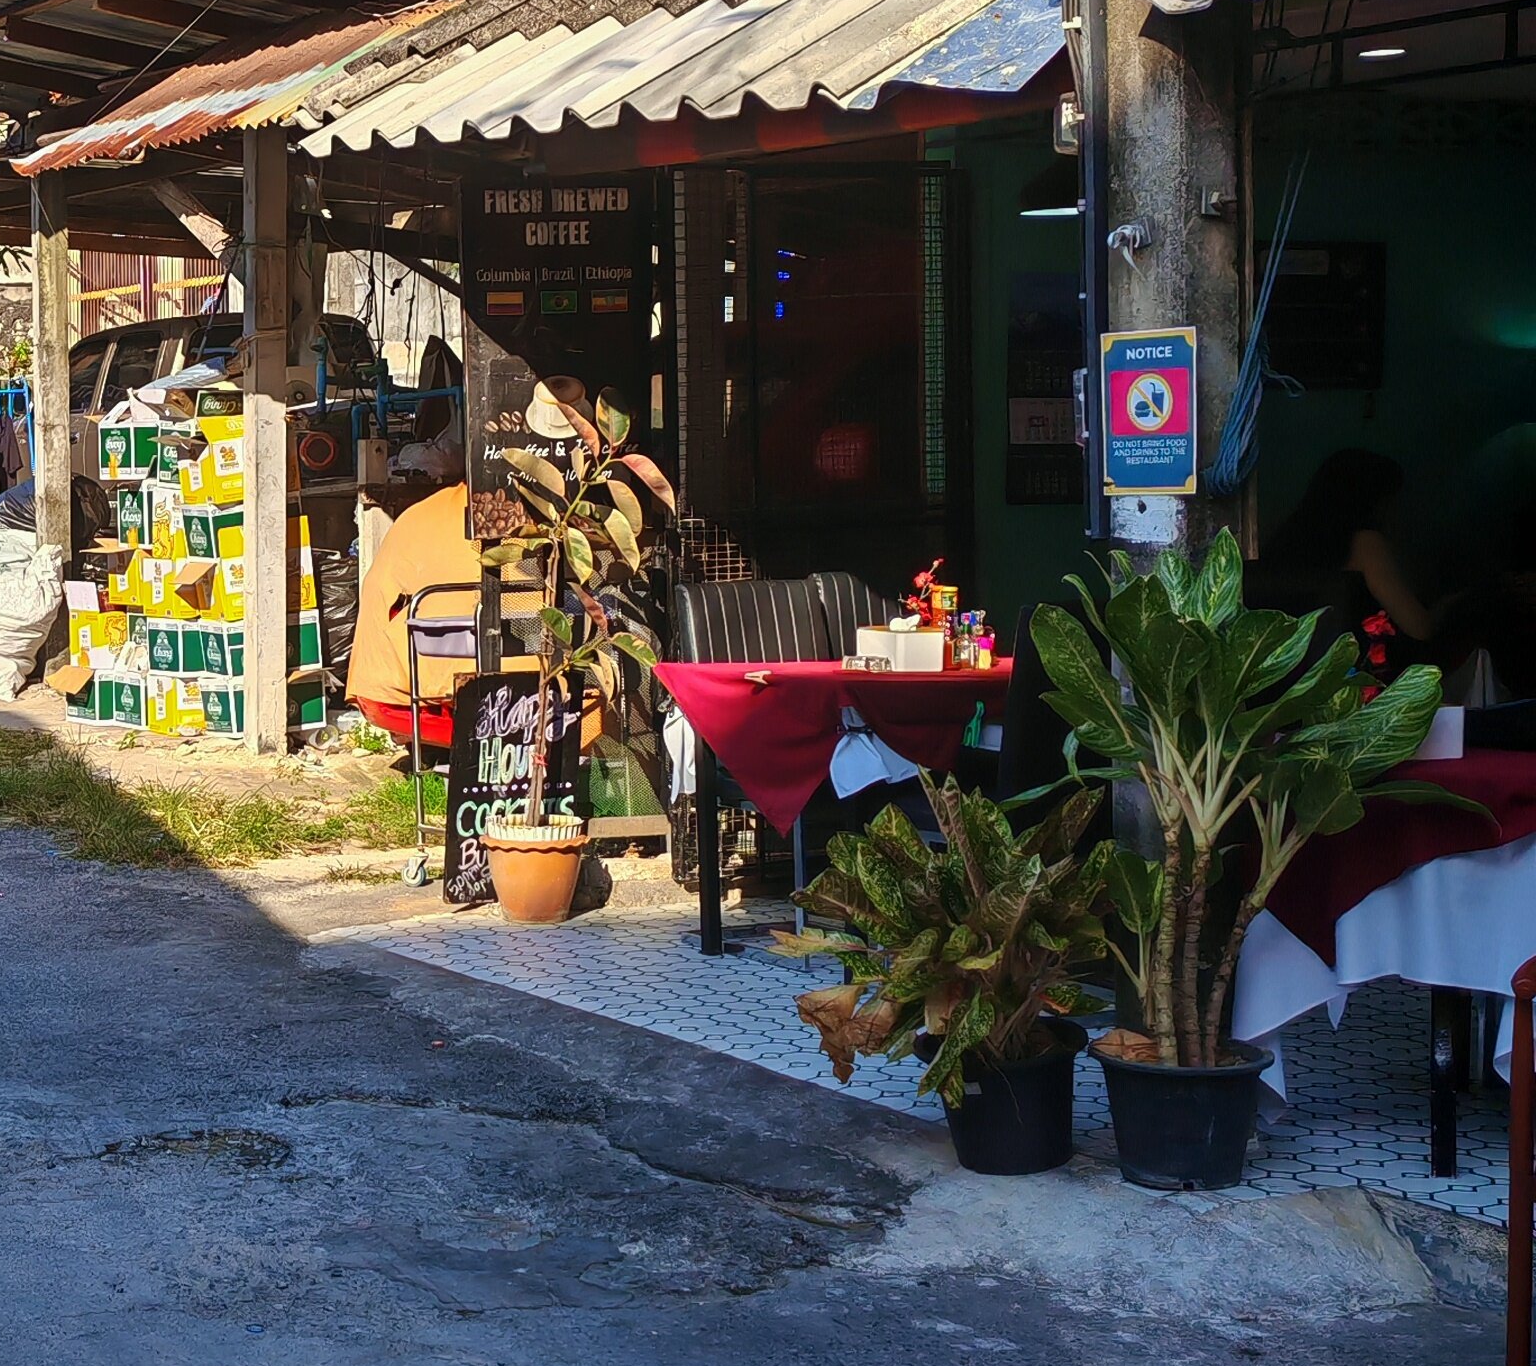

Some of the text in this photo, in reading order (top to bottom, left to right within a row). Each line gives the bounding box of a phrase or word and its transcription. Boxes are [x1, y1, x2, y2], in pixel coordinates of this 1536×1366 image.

[484, 187, 629, 214] FRESH BREWED
[525, 221, 590, 246] COFFEE
[476, 266, 633, 283] Columbia Brazil Ethiopia
[1126, 345, 1173, 361] NOTICE
[1125, 440, 1141, 448] NOT
[1142, 439, 1164, 447] BRING
[1166, 438, 1187, 447] FOOD
[1113, 447, 1186, 456] AND DRINKS TO THE
[1125, 455, 1174, 465] RESTAURANT
